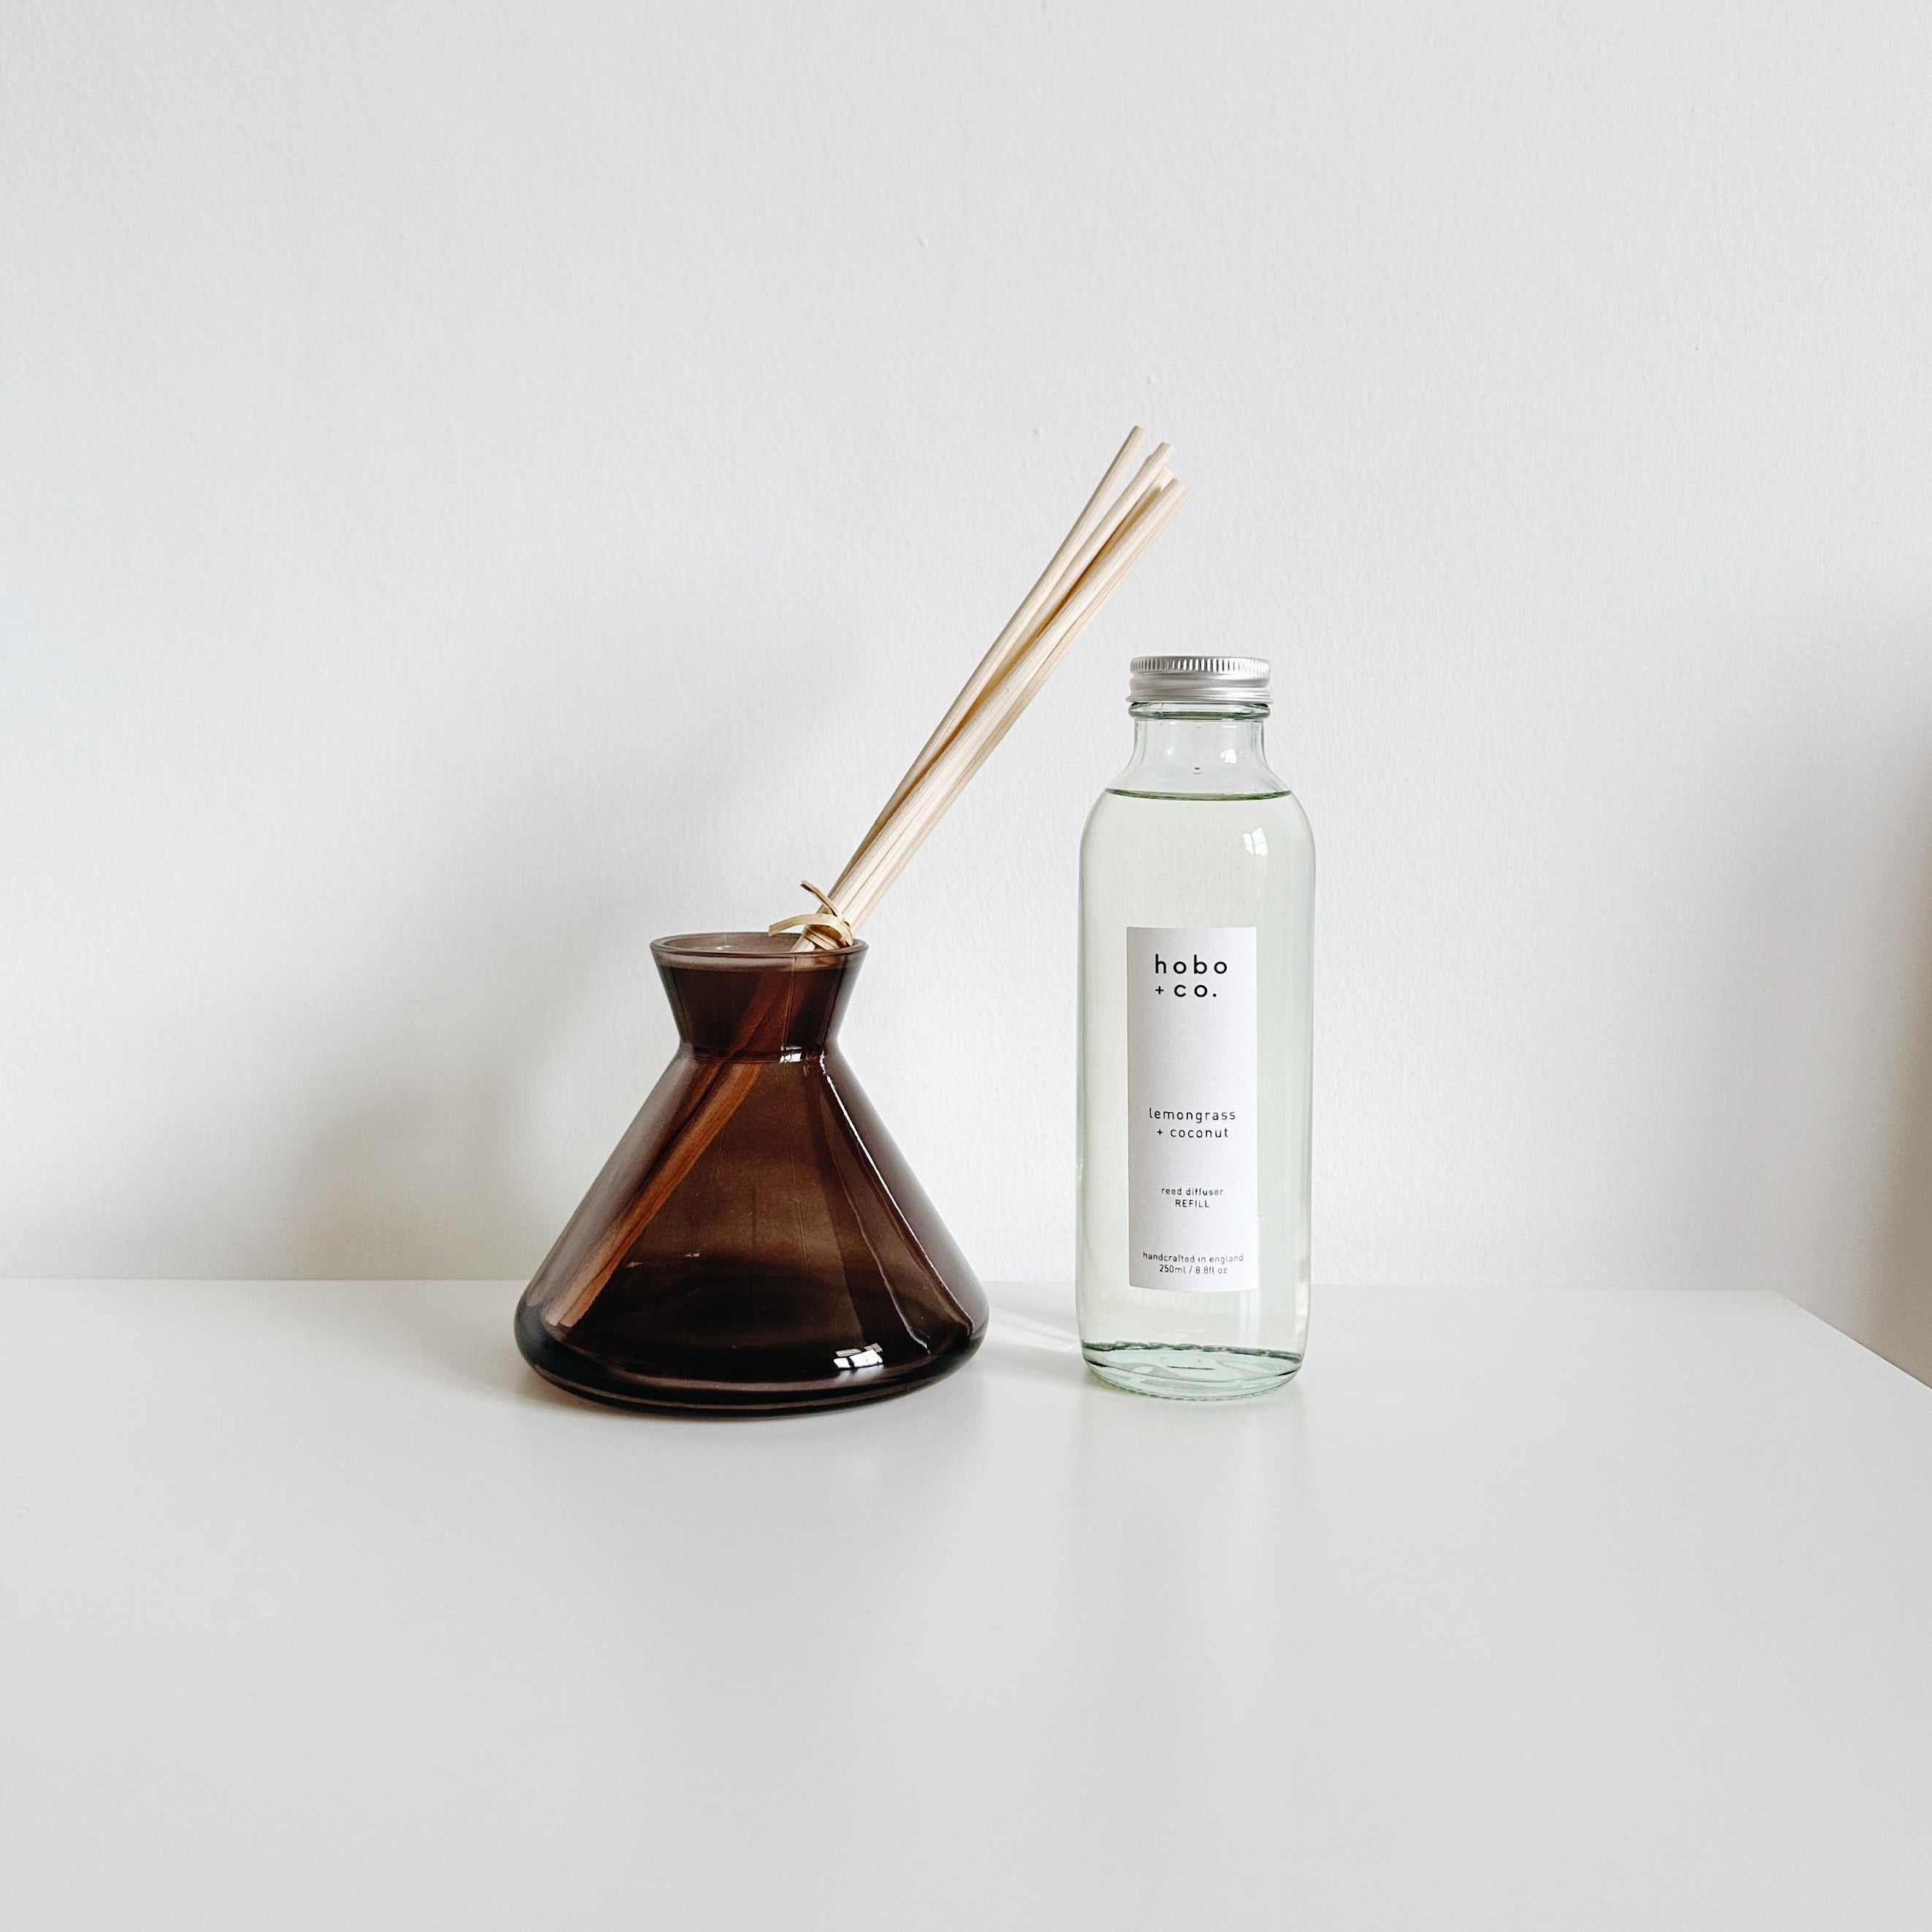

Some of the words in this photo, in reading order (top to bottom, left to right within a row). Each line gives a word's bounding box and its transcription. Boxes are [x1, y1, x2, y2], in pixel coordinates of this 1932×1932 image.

[1155, 953, 1228, 975] hobo
[1155, 985, 1165, 995] +
[1174, 984, 1217, 998] co.
[1149, 1107, 1236, 1124] lemongrass
[1170, 1127, 1229, 1138] coconut
[1161, 1187, 1182, 1195] reed
[1186, 1187, 1224, 1195] diffuser
[1175, 1199, 1211, 1208] REFILL
[1143, 1251, 1195, 1263] handcrafted
[1209, 1254, 1244, 1265] england
[1159, 1264, 1187, 1274] 250ml
